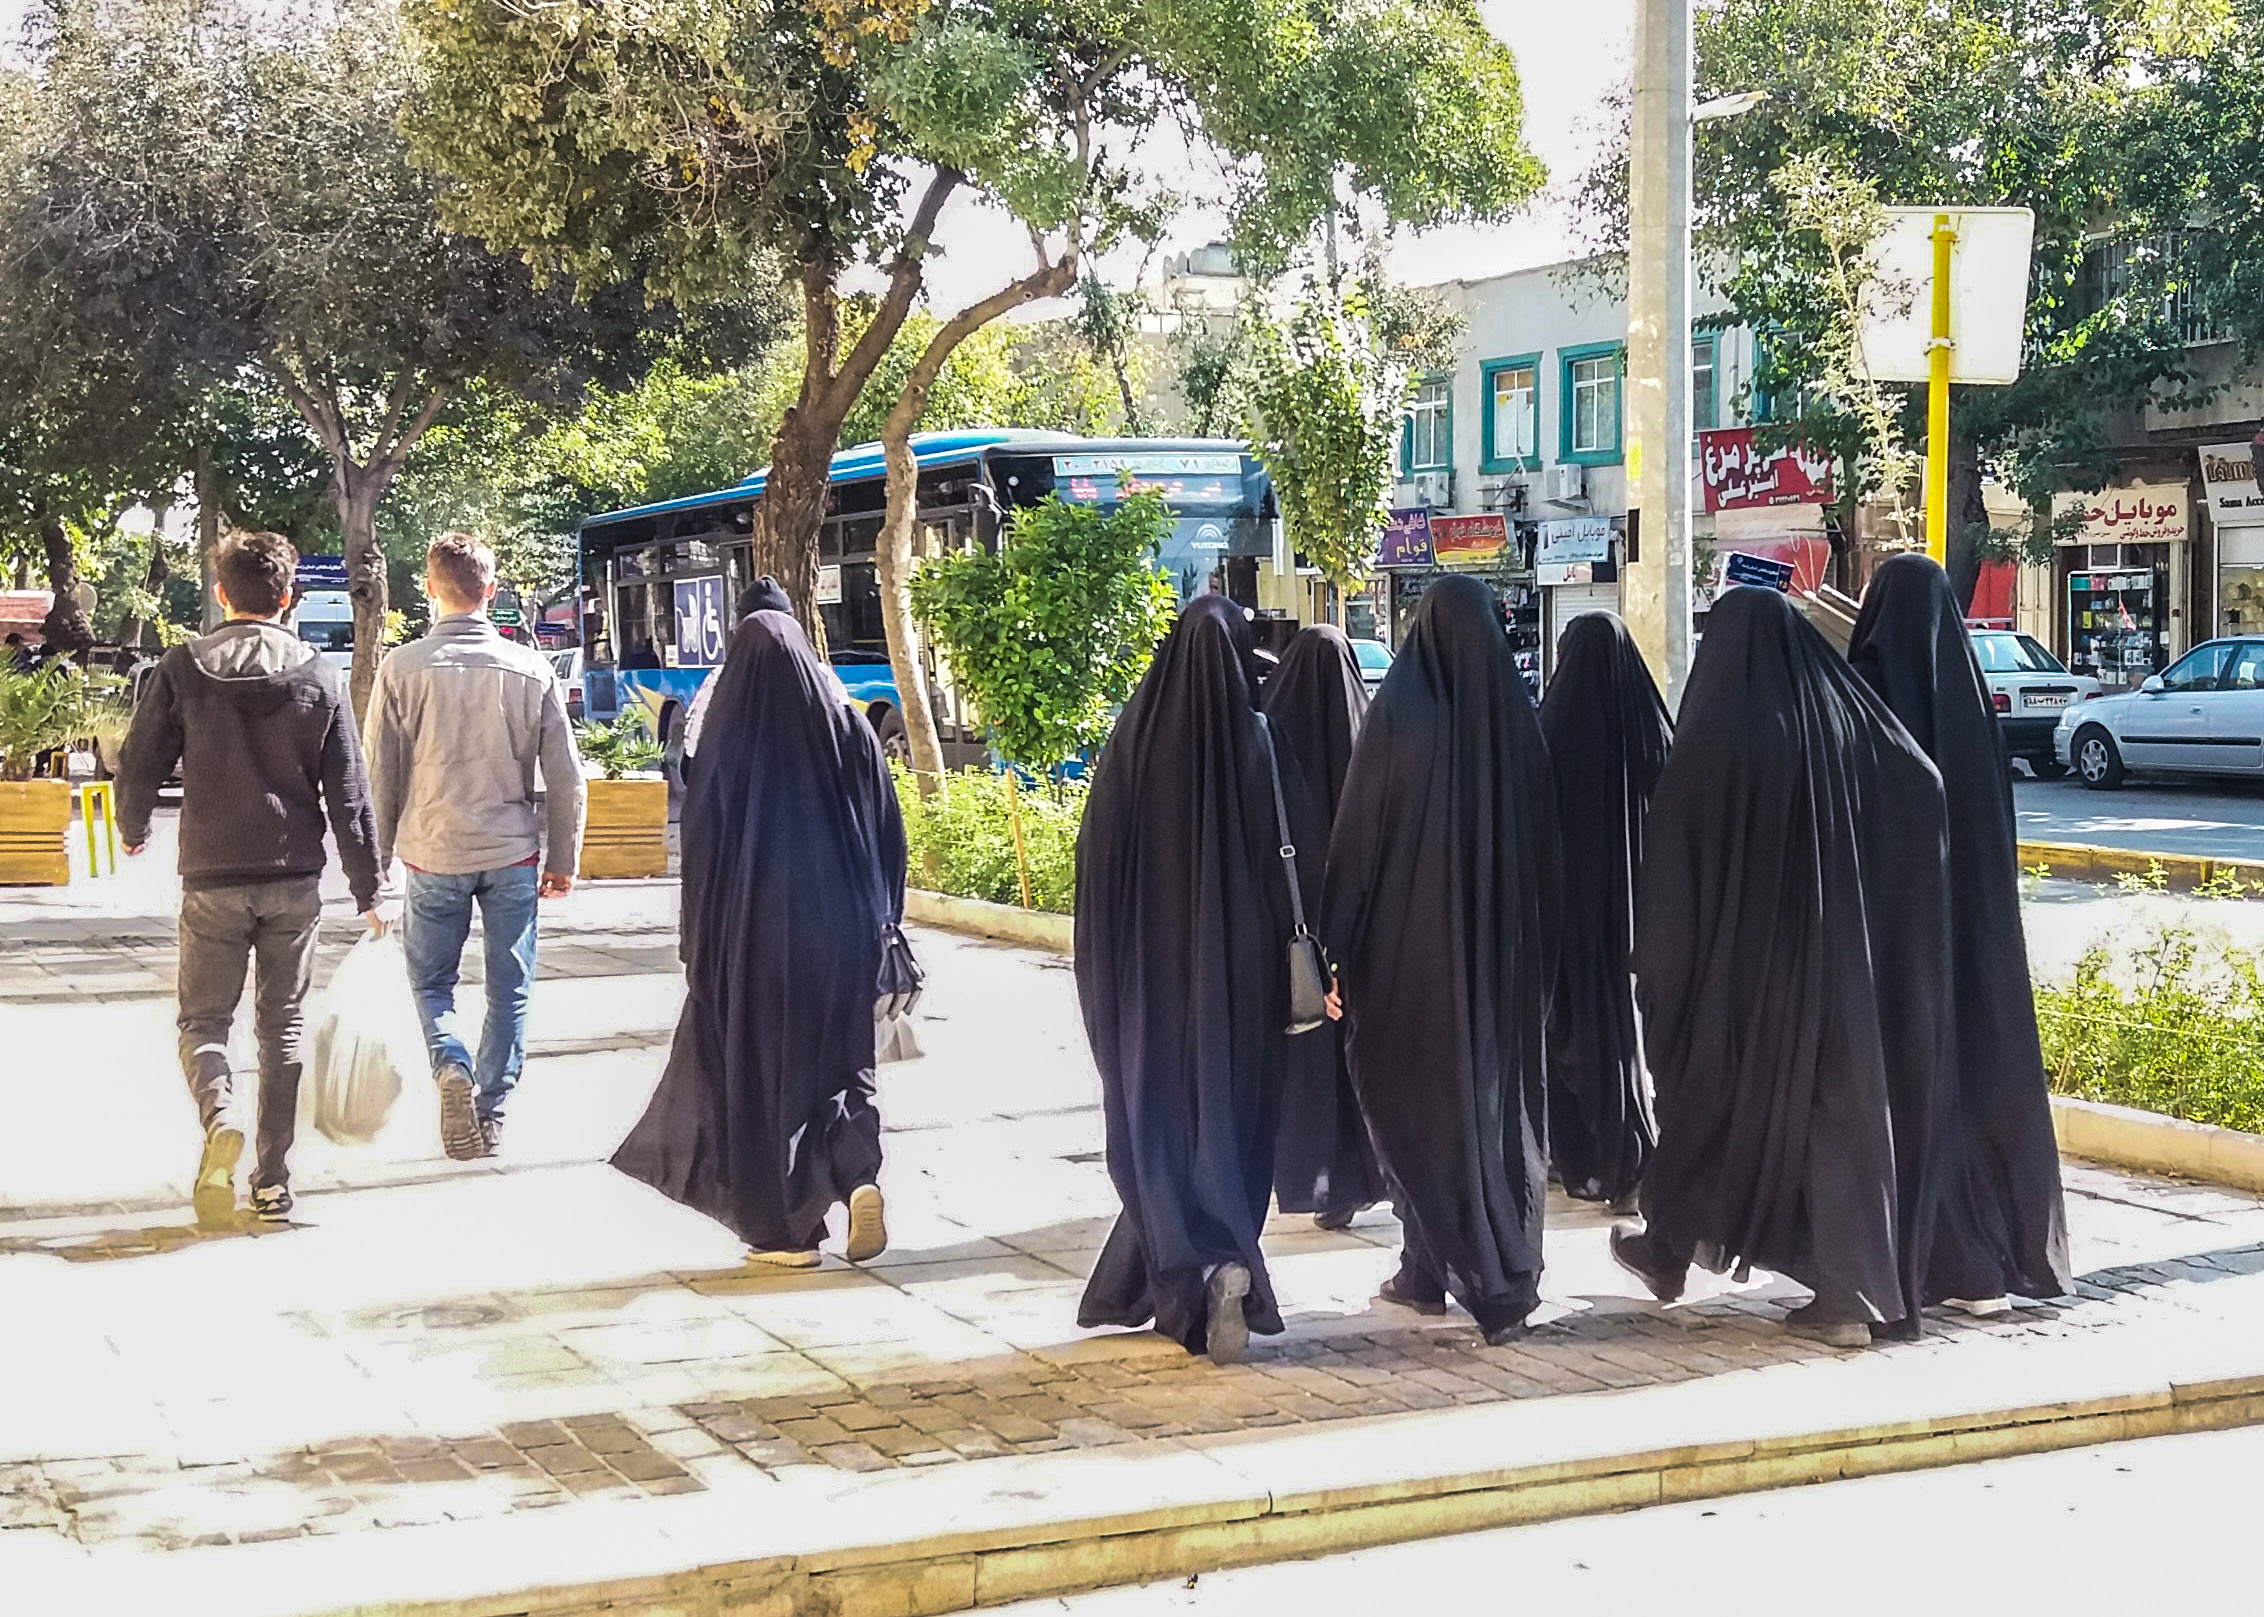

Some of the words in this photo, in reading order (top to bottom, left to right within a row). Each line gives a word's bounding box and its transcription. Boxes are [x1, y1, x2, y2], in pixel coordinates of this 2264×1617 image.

[1705, 435, 1740, 487] مرغ
[1718, 478, 1746, 508] علی
[1748, 469, 1780, 500] امیر
[2104, 498, 2177, 526] موبایل
[1396, 535, 1428, 559] قوام
[1577, 523, 1605, 542] موبایل
